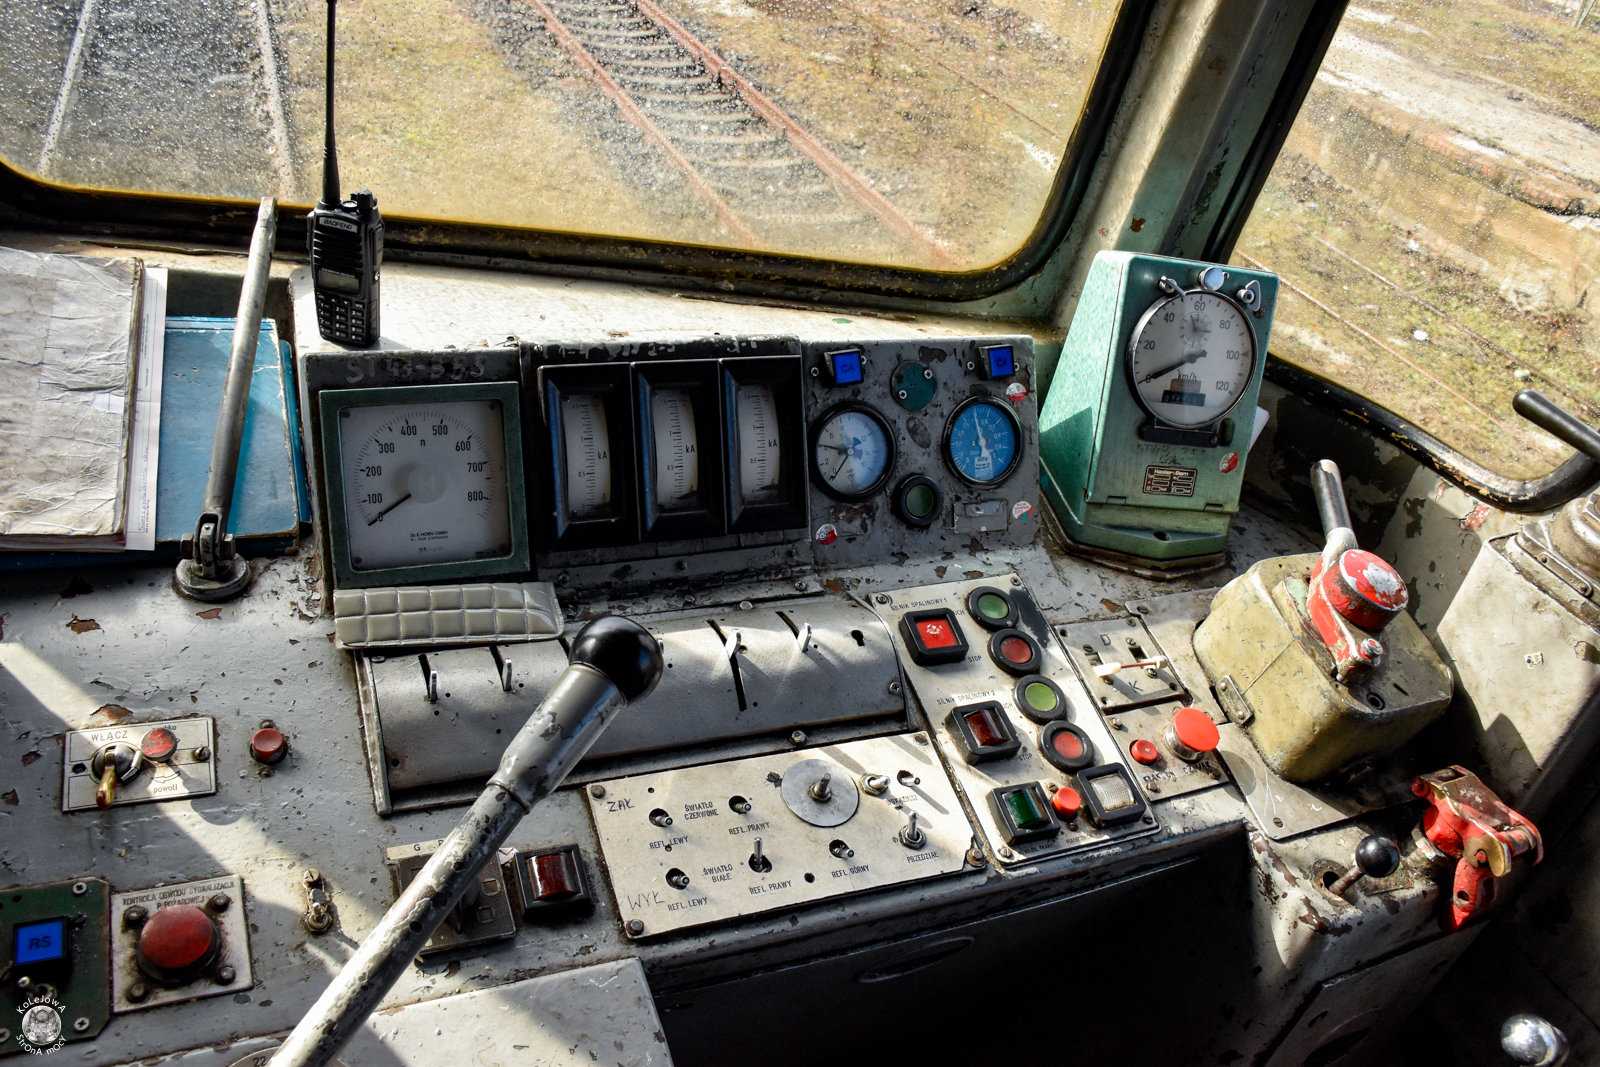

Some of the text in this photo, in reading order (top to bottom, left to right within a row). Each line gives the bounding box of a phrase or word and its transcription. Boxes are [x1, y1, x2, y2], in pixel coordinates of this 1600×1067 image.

[324, 218, 352, 230] BAOFENG
[1194, 301, 1205, 311] 60
[1164, 312, 1175, 323] 40
[1219, 320, 1231, 330] 80
[1143, 340, 1155, 350] 20
[1226, 350, 1239, 360] 100
[996, 358, 1007, 367] CA
[1178, 370, 1197, 380] km/h
[1216, 380, 1229, 391] 120
[401, 425, 417, 436] 400
[432, 425, 448, 436] 500
[378, 443, 395, 454] 300
[455, 441, 470, 451] 600
[686, 444, 695, 453] kA
[598, 451, 607, 460] kA
[366, 466, 382, 476] 200
[467, 462, 482, 473] 700
[367, 494, 382, 504] 100
[468, 491, 483, 502] 800
[378, 512, 383, 522] 0
[890, 603, 910, 611] SILNIK
[911, 598, 943, 608] SPALINOWY
[1100, 634, 1111, 646] D
[1128, 680, 1143, 693] K
[936, 696, 955, 705] SILNIK
[958, 691, 990, 701] SPALINOWY
[91, 730, 128, 742] WŁĄCZ
[1018, 753, 1033, 761] STOP
[153, 784, 178, 794] powoli
[607, 798, 635, 812] ZAŁ
[684, 801, 713, 812] ŚWIATŁO
[684, 809, 719, 820] CZERWONE
[748, 821, 770, 832] PRAWY
[669, 836, 688, 846] LEWY
[414, 843, 421, 851] G
[906, 851, 939, 863] PRZEDZIAŁ
[703, 864, 733, 876] ŚWIATŁO
[712, 872, 732, 883] BIAŁE
[769, 880, 792, 891] PRAWY
[123, 881, 234, 905] KONTROLA OBWODU SYGNALIZACJI
[164, 895, 205, 908] POŻAROWEJ
[627, 890, 666, 911] WYŁ
[688, 897, 708, 908] LEWY
[28, 935, 52, 950] RS
[253, 1056, 267, 1067] 22
